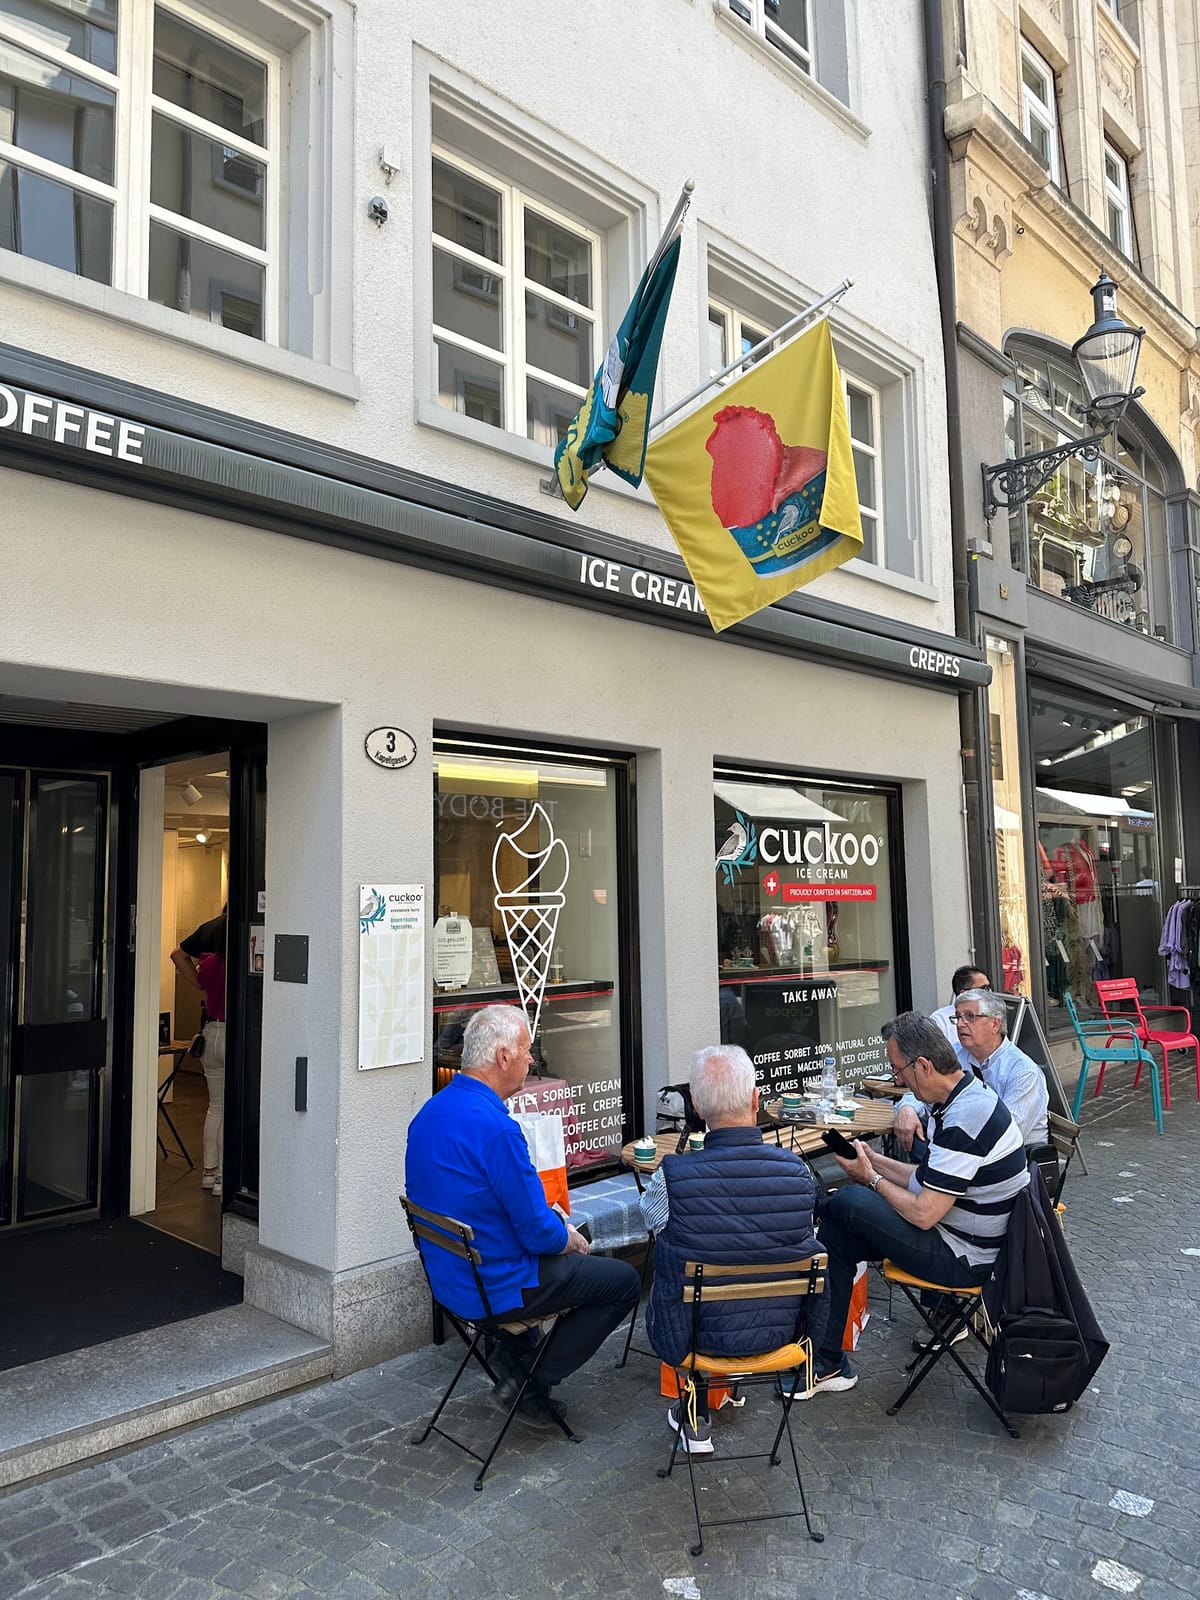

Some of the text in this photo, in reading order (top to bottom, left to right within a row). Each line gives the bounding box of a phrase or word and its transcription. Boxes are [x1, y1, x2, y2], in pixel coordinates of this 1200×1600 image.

[0, 383, 146, 465] OFFEE
[777, 526, 815, 550] cuckoo
[580, 555, 621, 593] ICE
[910, 646, 960, 677] CREPES
[386, 731, 396, 753] 3
[796, 868, 848, 879] ICE CREAM
[388, 892, 422, 902] cuckoo
[789, 888, 812, 897] PROUDLY
[813, 888, 835, 897] CRAFTED
[841, 888, 873, 897] SWITZERLAND
[782, 987, 838, 1004] TAKE AWAY
[754, 1051, 781, 1065] COFFEE
[784, 1046, 811, 1060] SORBET
[815, 1043, 833, 1055] 100%
[836, 1038, 865, 1051] NATURAL
[770, 1065, 792, 1078] LATTE
[841, 1054, 856, 1065] ICED
[857, 1049, 880, 1062] COFFEE
[775, 1079, 799, 1093] CAKES
[845, 1063, 883, 1079] CAPPUCCINO
[542, 1085, 583, 1103] SORBET
[587, 1078, 622, 1095] VEGAN
[593, 1096, 624, 1112] CREPE
[562, 1113, 627, 1137] COFFEE CAKE
[565, 1132, 623, 1156] APPUCCINO
